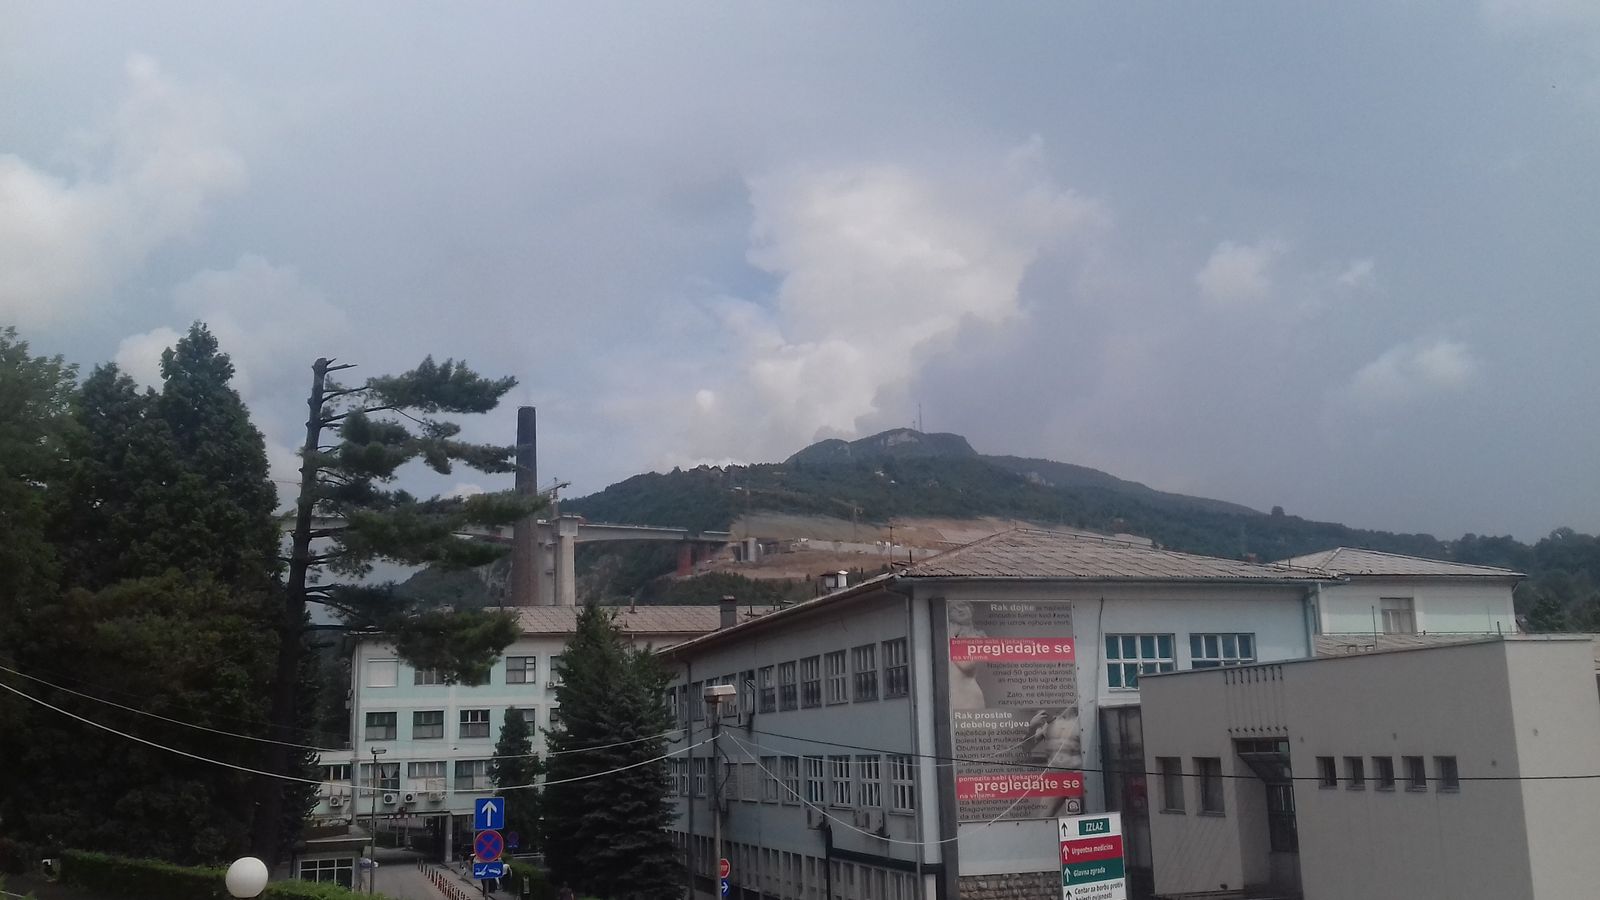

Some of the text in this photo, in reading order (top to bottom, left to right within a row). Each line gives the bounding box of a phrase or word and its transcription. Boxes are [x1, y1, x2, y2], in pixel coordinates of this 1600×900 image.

[990, 603, 1008, 611] Rak
[1010, 603, 1035, 612] dojke
[967, 642, 1071, 656] pregledajte se
[975, 711, 1013, 720] prostate
[960, 721, 997, 729] debelog
[999, 720, 1030, 728] crijeva
[974, 778, 1080, 794] pregledajte se
[1085, 821, 1104, 832] IZLAZ
[1093, 844, 1113, 852] medicina
[1073, 866, 1106, 877] Glavna zgrada
[1074, 886, 1090, 895] Centar
[1096, 884, 1109, 892] borbu
[1110, 881, 1123, 891] protiv
